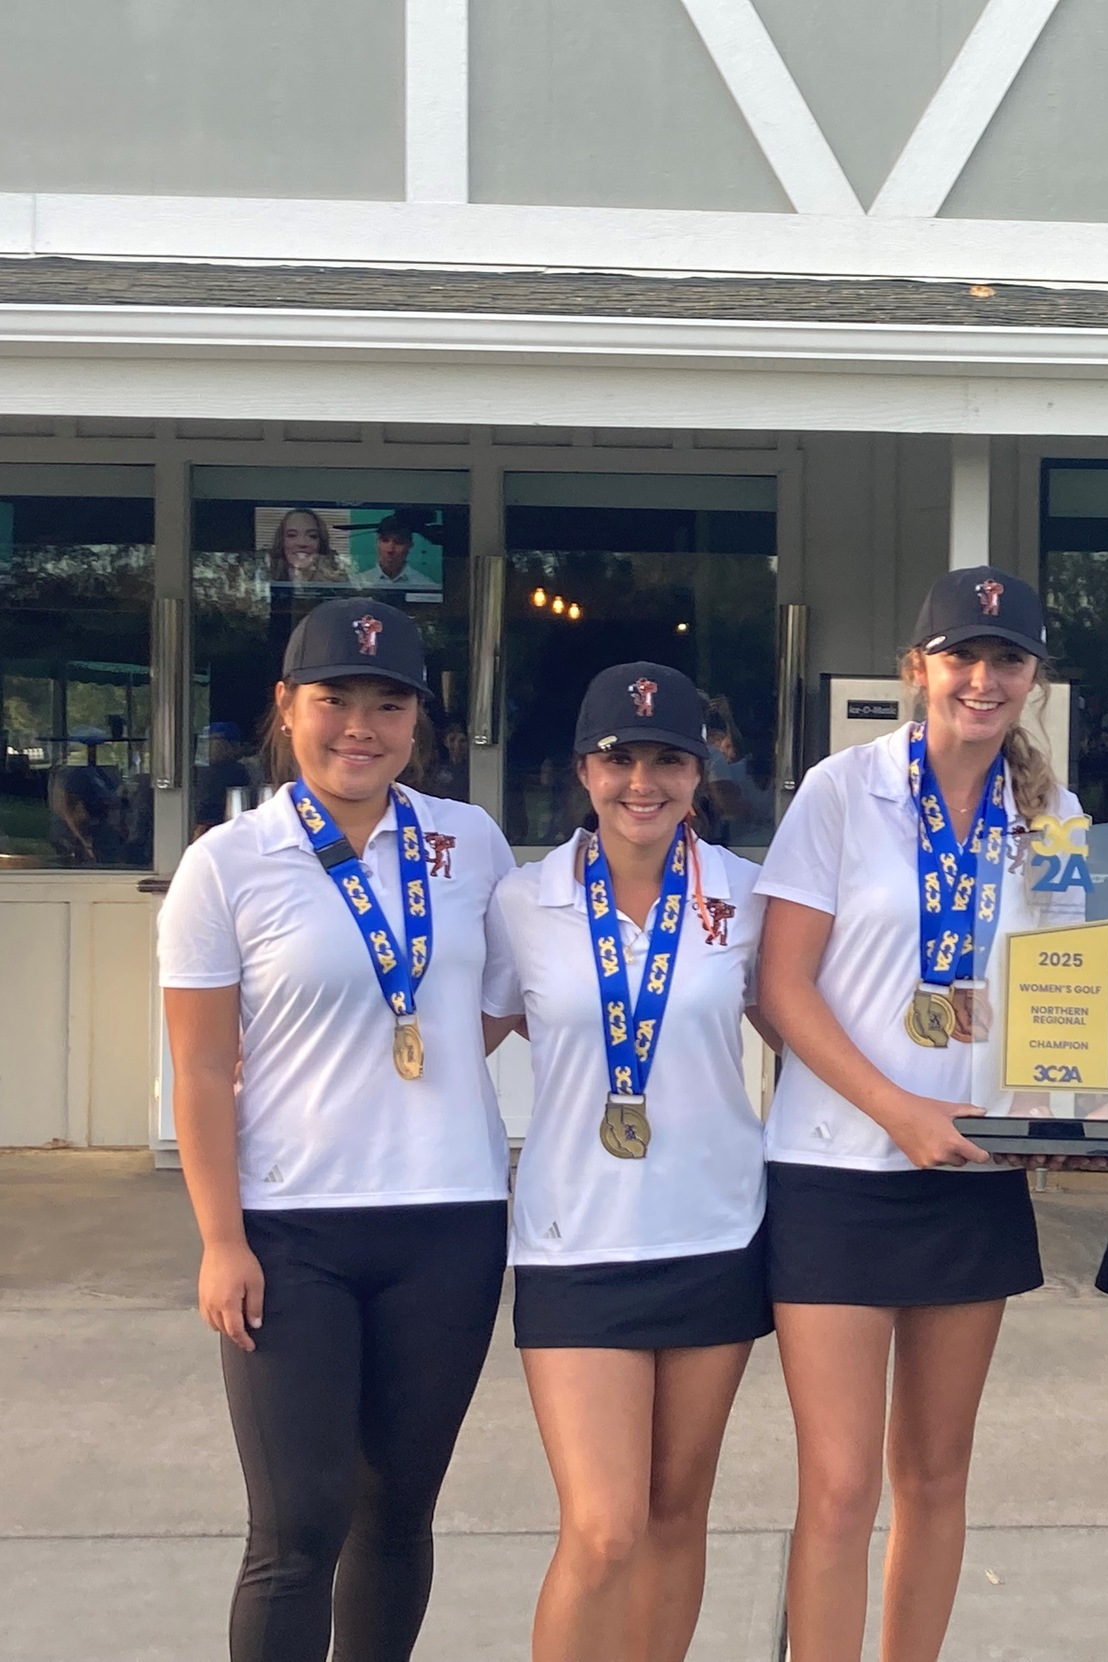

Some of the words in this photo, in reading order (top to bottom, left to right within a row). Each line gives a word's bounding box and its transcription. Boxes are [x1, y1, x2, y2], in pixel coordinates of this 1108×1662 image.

[297, 797, 326, 834] 3C2A
[921, 794, 945, 833] 3C2A
[402, 826, 421, 862] 3C2A
[986, 826, 1003, 865] 3C2A
[1030, 814, 1090, 857] 3C
[925, 871, 941, 914] 3C2A
[952, 873, 975, 911] 3C2A
[1031, 854, 1096, 893] 2A
[342, 874, 373, 916] 3C2A
[408, 879, 426, 917] 3C2A
[590, 880, 610, 919] 3C2A
[661, 894, 682, 934] 3C2A
[979, 883, 997, 922] 3C2A
[370, 930, 397, 974] 3C2A
[411, 935, 427, 978] 3C2A
[598, 936, 620, 977] 3C2A
[934, 930, 959, 972] 3C2A
[1039, 952, 1083, 967] 2025
[648, 953, 670, 995] 3C2A
[1019, 983, 1072, 994] WOMEN'S
[1074, 985, 1102, 995] GOLF
[391, 991, 406, 1015] 3C
[1031, 1006, 1089, 1016] NORTHERN
[1032, 1015, 1087, 1026] REGIONAL
[607, 1000, 628, 1046] 3C2A
[1029, 1039, 1089, 1050] CHAMPION
[1033, 1064, 1083, 1084] 3C2A
